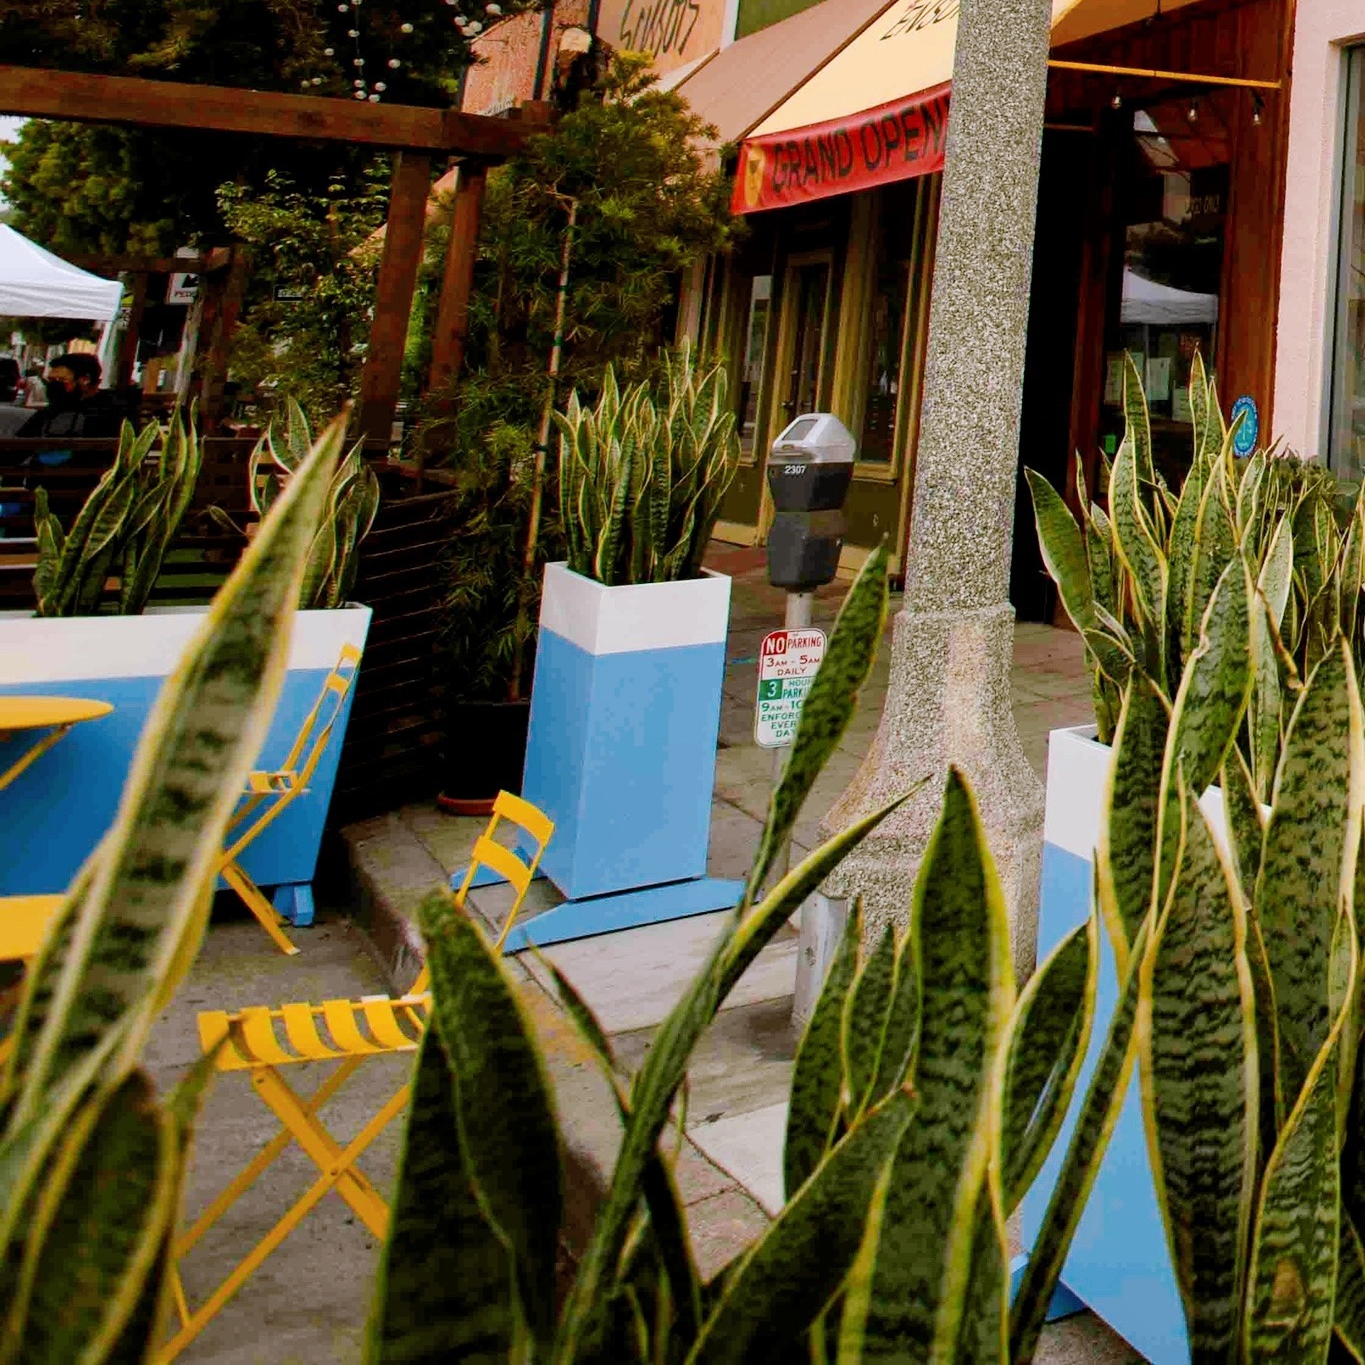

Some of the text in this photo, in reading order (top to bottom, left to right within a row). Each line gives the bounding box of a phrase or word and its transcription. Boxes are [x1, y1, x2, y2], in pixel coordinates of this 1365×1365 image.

[772, 126, 855, 194] GRAND
[784, 465, 806, 475] 2307
[765, 636, 822, 655] NO PARKING
[766, 657, 788, 668] 3AM
[799, 654, 821, 665] 5AM
[777, 667, 807, 676] DAILY
[767, 681, 778, 698] 3
[760, 702, 783, 713] 9AM
[771, 720, 797, 730] EVER
